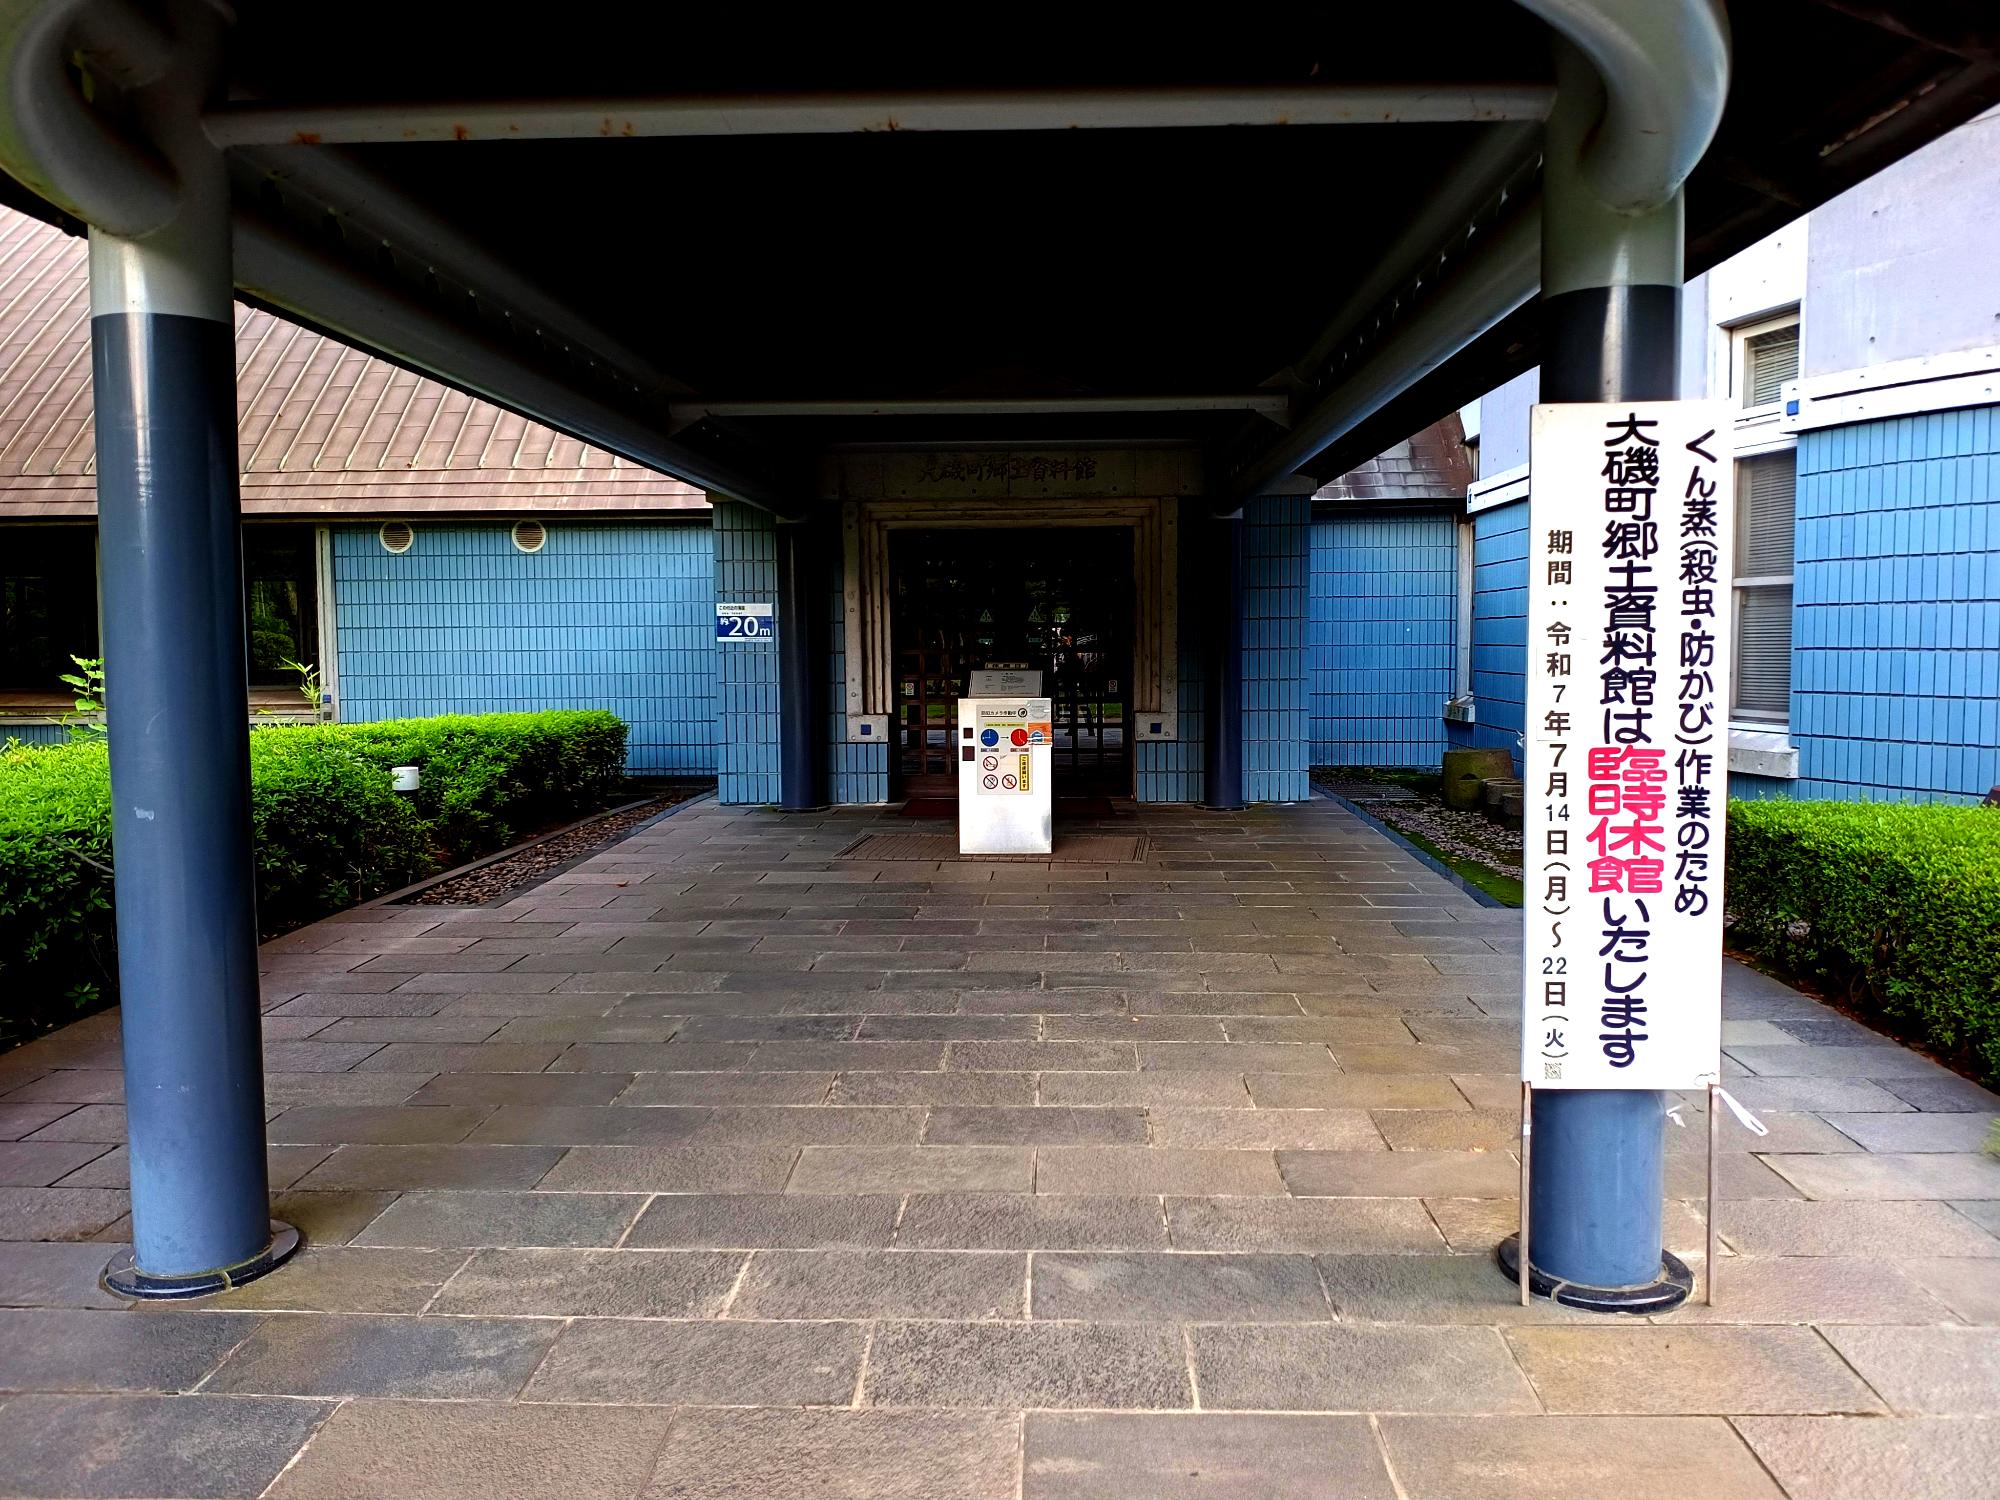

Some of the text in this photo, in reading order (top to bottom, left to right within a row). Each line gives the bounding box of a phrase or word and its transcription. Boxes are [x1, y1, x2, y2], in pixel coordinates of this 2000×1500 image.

[720, 616, 770, 636] 約20m
[1586, 413, 1667, 1067] 大磯町郷土資料館は臨時休館いたします
[1674, 429, 1719, 917] くん蒸(殺虫・防かび)作業のため
